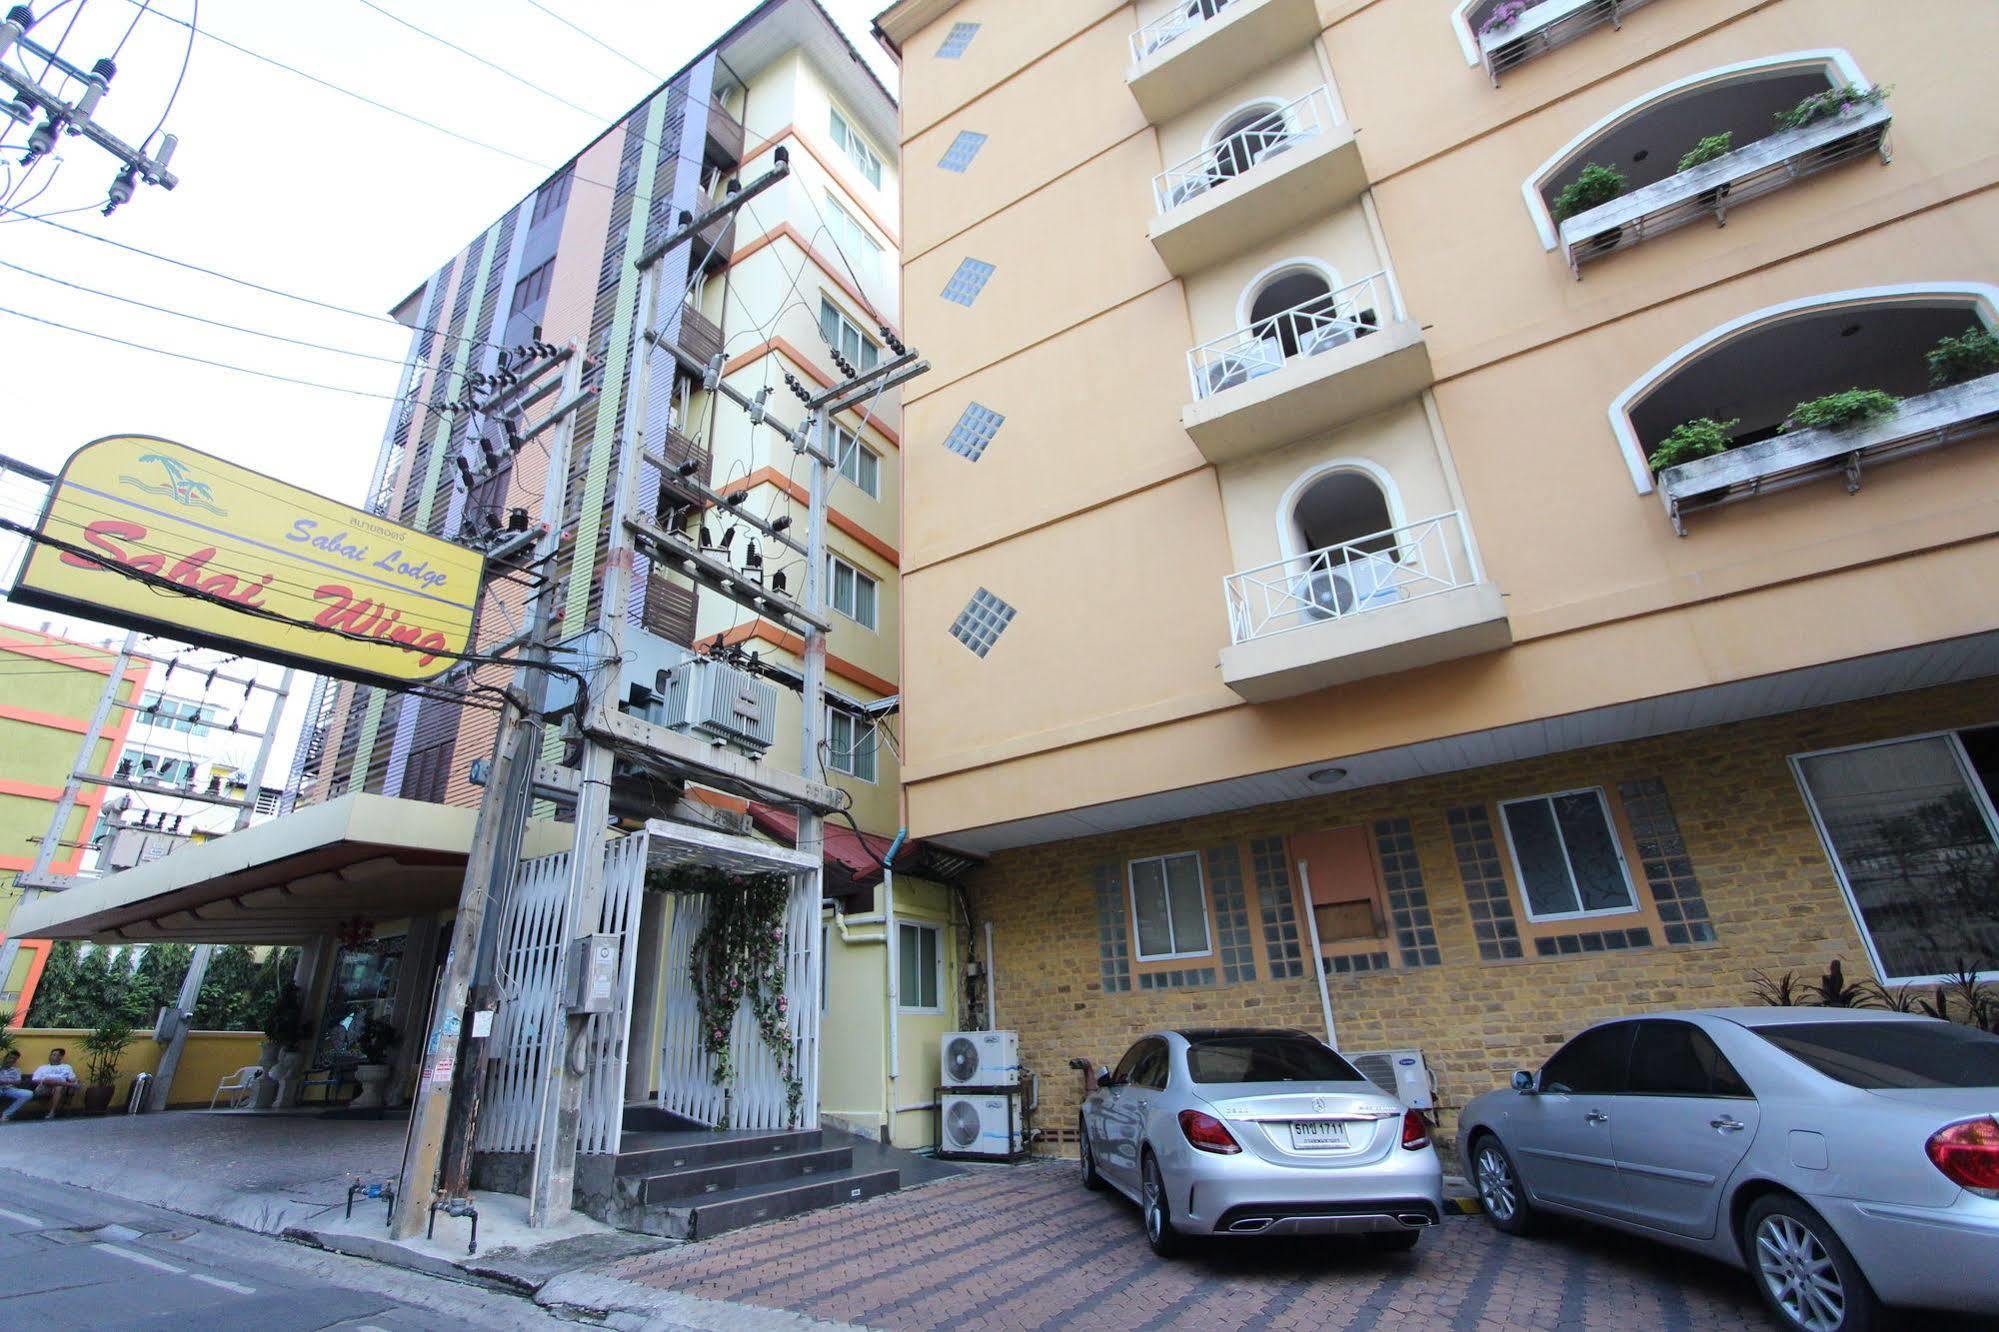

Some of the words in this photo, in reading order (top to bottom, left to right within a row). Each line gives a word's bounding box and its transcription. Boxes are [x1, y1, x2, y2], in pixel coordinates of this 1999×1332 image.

[285, 519, 370, 562] Sabai
[372, 550, 449, 589] Lodge
[59, 520, 274, 608] Sabai
[313, 584, 452, 668] Wing
[1319, 1122, 1343, 1135] 1711
